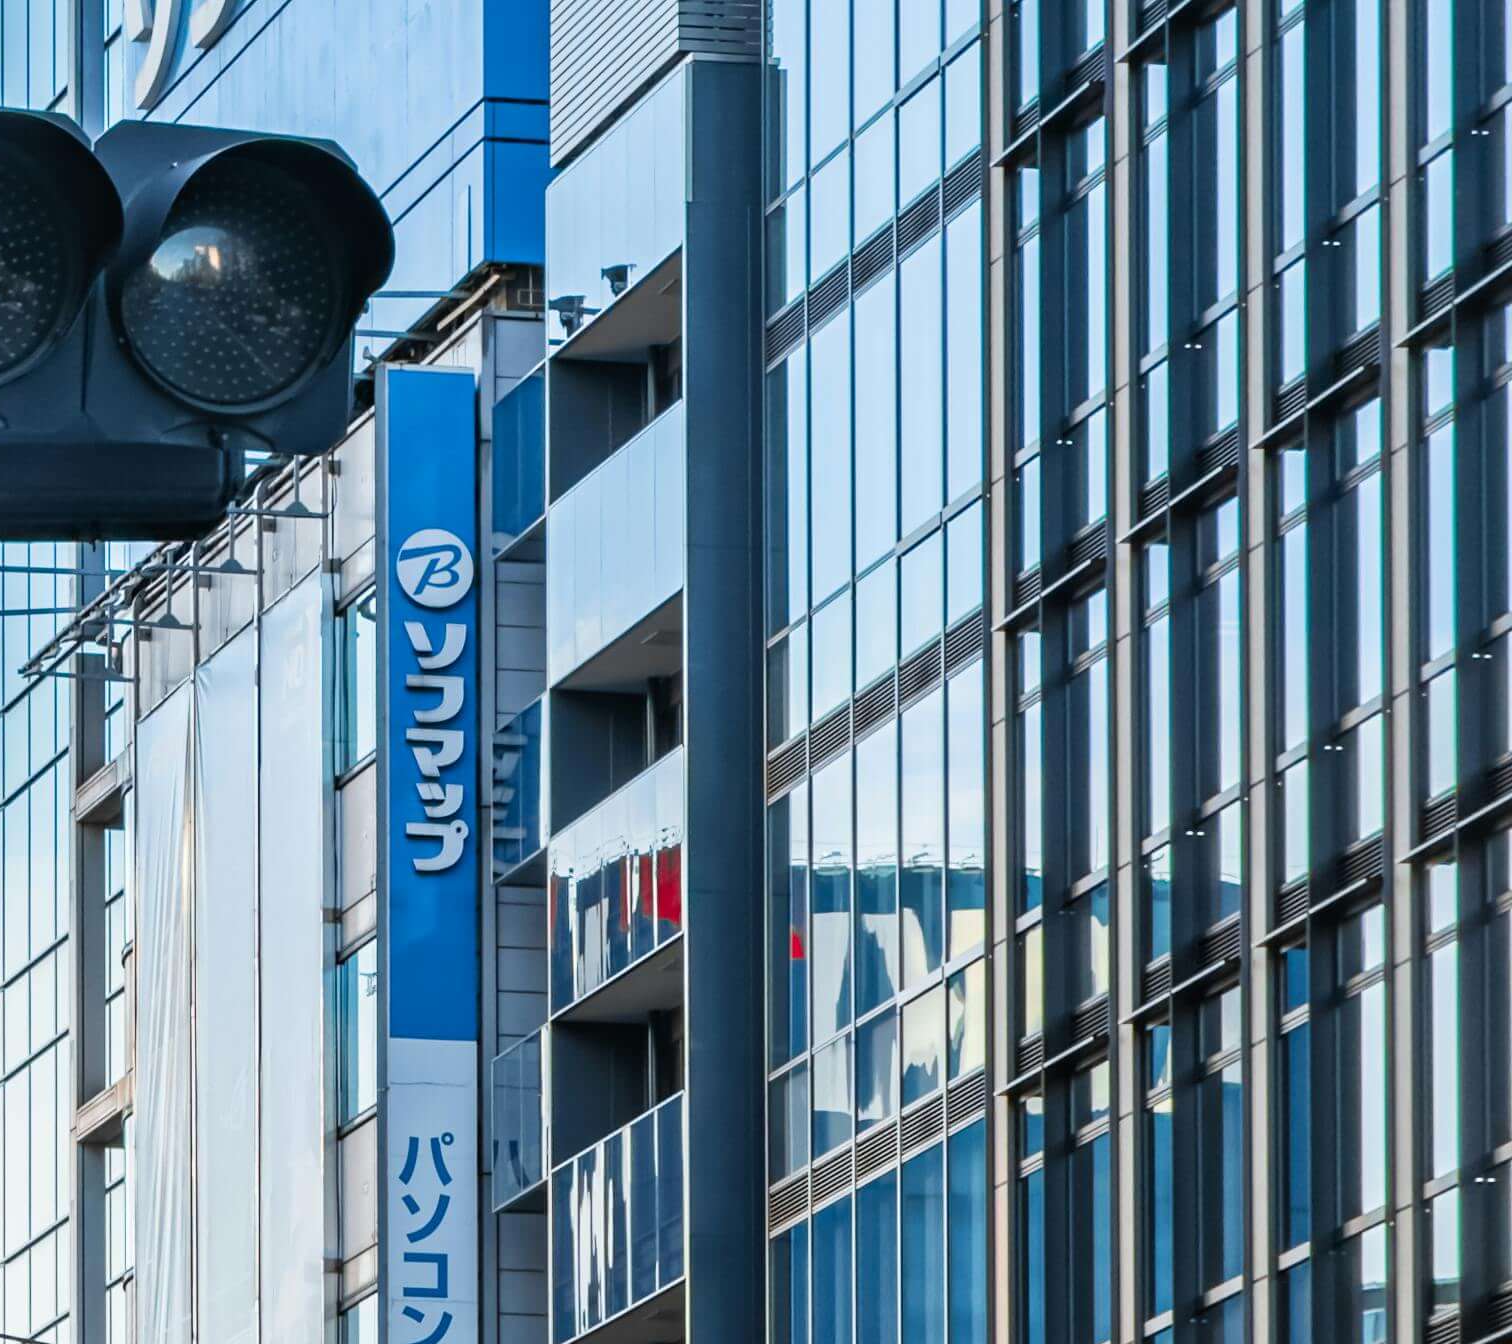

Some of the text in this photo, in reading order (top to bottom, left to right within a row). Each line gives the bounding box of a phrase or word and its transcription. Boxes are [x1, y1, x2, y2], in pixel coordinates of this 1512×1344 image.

[403, 620, 469, 872] ソフマップ
